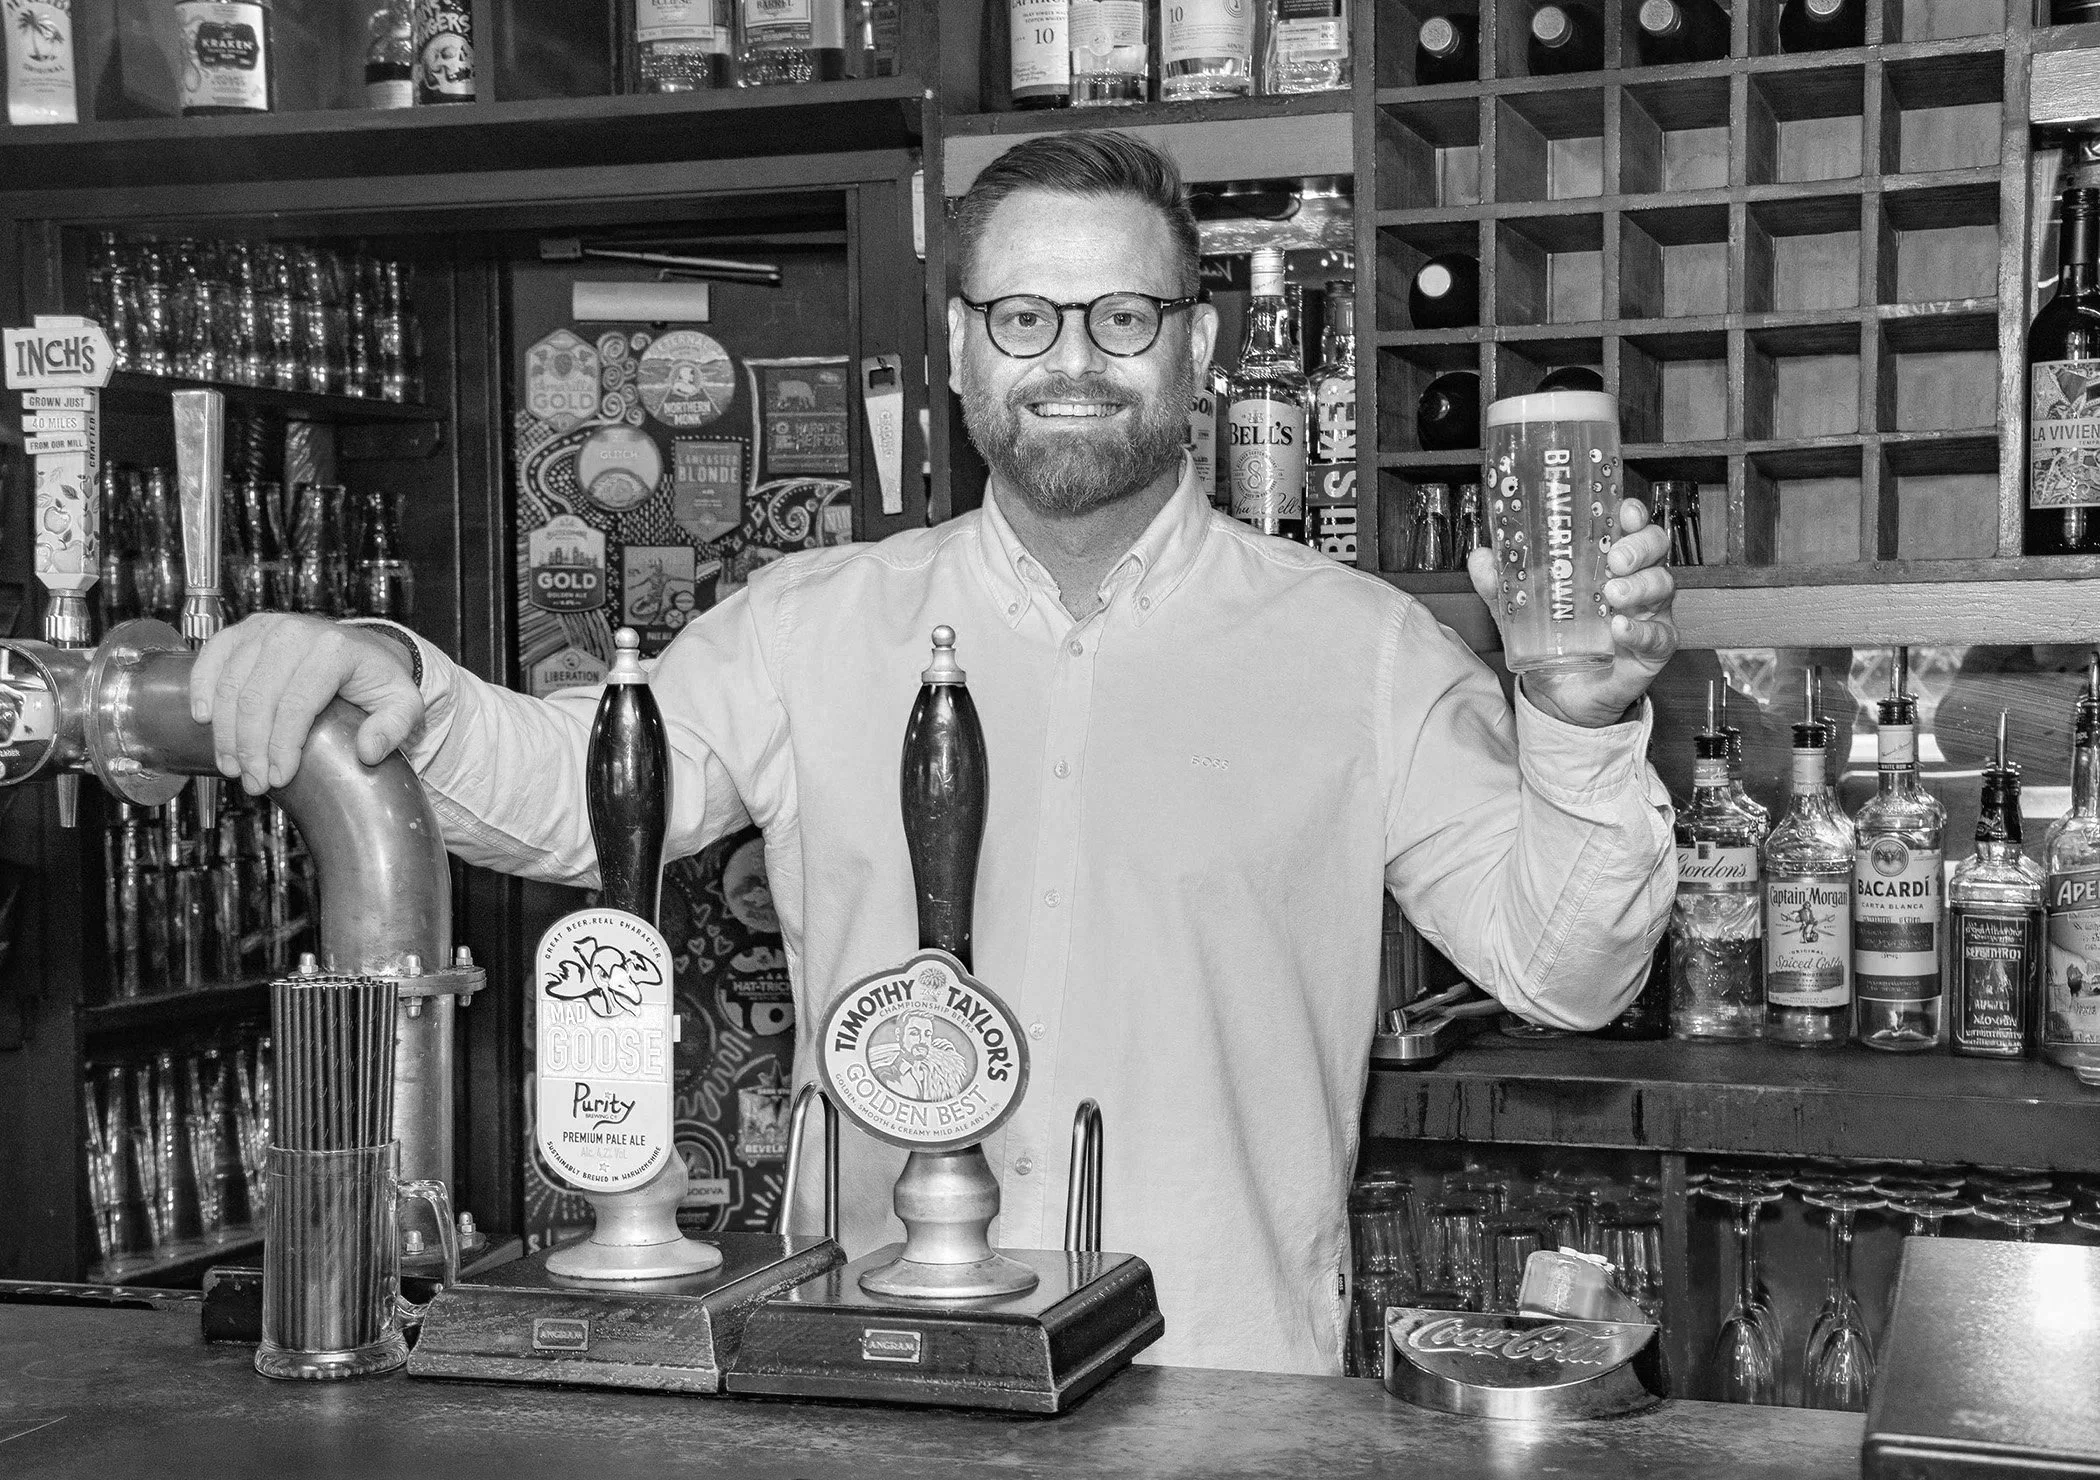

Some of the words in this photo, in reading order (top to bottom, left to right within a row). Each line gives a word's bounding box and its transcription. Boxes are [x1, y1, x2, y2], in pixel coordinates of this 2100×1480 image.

[1170, 6, 1184, 23] 10
[201, 39, 254, 50] KRAKEN
[1034, 28, 1054, 44] 10
[15, 336, 95, 376] INCH'S
[29, 397, 61, 408] GROWN
[64, 397, 85, 408] JUST
[533, 393, 594, 409] GOLD
[32, 418, 45, 429] 40
[49, 417, 78, 429] MILES
[1229, 421, 1294, 446] BELL'S
[2033, 427, 2046, 441] LA
[2050, 424, 2100, 440] VIVIEN
[30, 441, 50, 450] FROM
[51, 440, 66, 449] OUR
[67, 438, 84, 448] MILL
[88, 417, 96, 468] CRAFTED
[677, 454, 739, 466] LANCASTER
[678, 466, 739, 484] BLONDE
[1544, 449, 1574, 622] BEAVERTOWN
[538, 572, 596, 589] GOLD
[575, 592, 588, 600] ALE
[544, 671, 600, 684] LIBERATION
[1191, 754, 1229, 770] BOSS
[1677, 853, 1747, 879] Gordon's
[1858, 875, 1930, 897] BACARDÍ
[2057, 880, 2100, 906] APE
[1770, 886, 1805, 907] Captain
[1810, 887, 1847, 908] Morgan
[545, 932, 563, 960] GREAT
[1775, 955, 1813, 970] Spiced
[550, 1003, 586, 1026] MAD
[879, 1001, 950, 1018] CHAMPIONSHIP
[952, 1011, 975, 1034] BEERS
[835, 979, 915, 1052] TIMOTHY
[946, 986, 1013, 1082] TAYLOR'S
[546, 1026, 664, 1076] GOOSE
[846, 1063, 928, 1127] GOLDEN
[936, 1084, 987, 1125] BEST
[573, 1082, 636, 1131] Purity
[585, 1113, 610, 1121] BREWING
[858, 1103, 889, 1129] SMOOTH
[897, 1126, 931, 1137] CREAMY
[933, 1127, 953, 1137] MILD
[954, 1124, 969, 1133] ALE
[970, 1114, 985, 1127] ABV
[563, 1131, 603, 1144] PREMIUM
[606, 1134, 627, 1146] PALE
[629, 1135, 646, 1146] ALE
[547, 1141, 580, 1176] SUSTAINABLY
[582, 1172, 609, 1183] BREWED
[622, 1146, 662, 1180] WARWICKSHIRE
[540, 1329, 583, 1341] ANGRAM
[868, 1339, 914, 1351] ANGRAM
